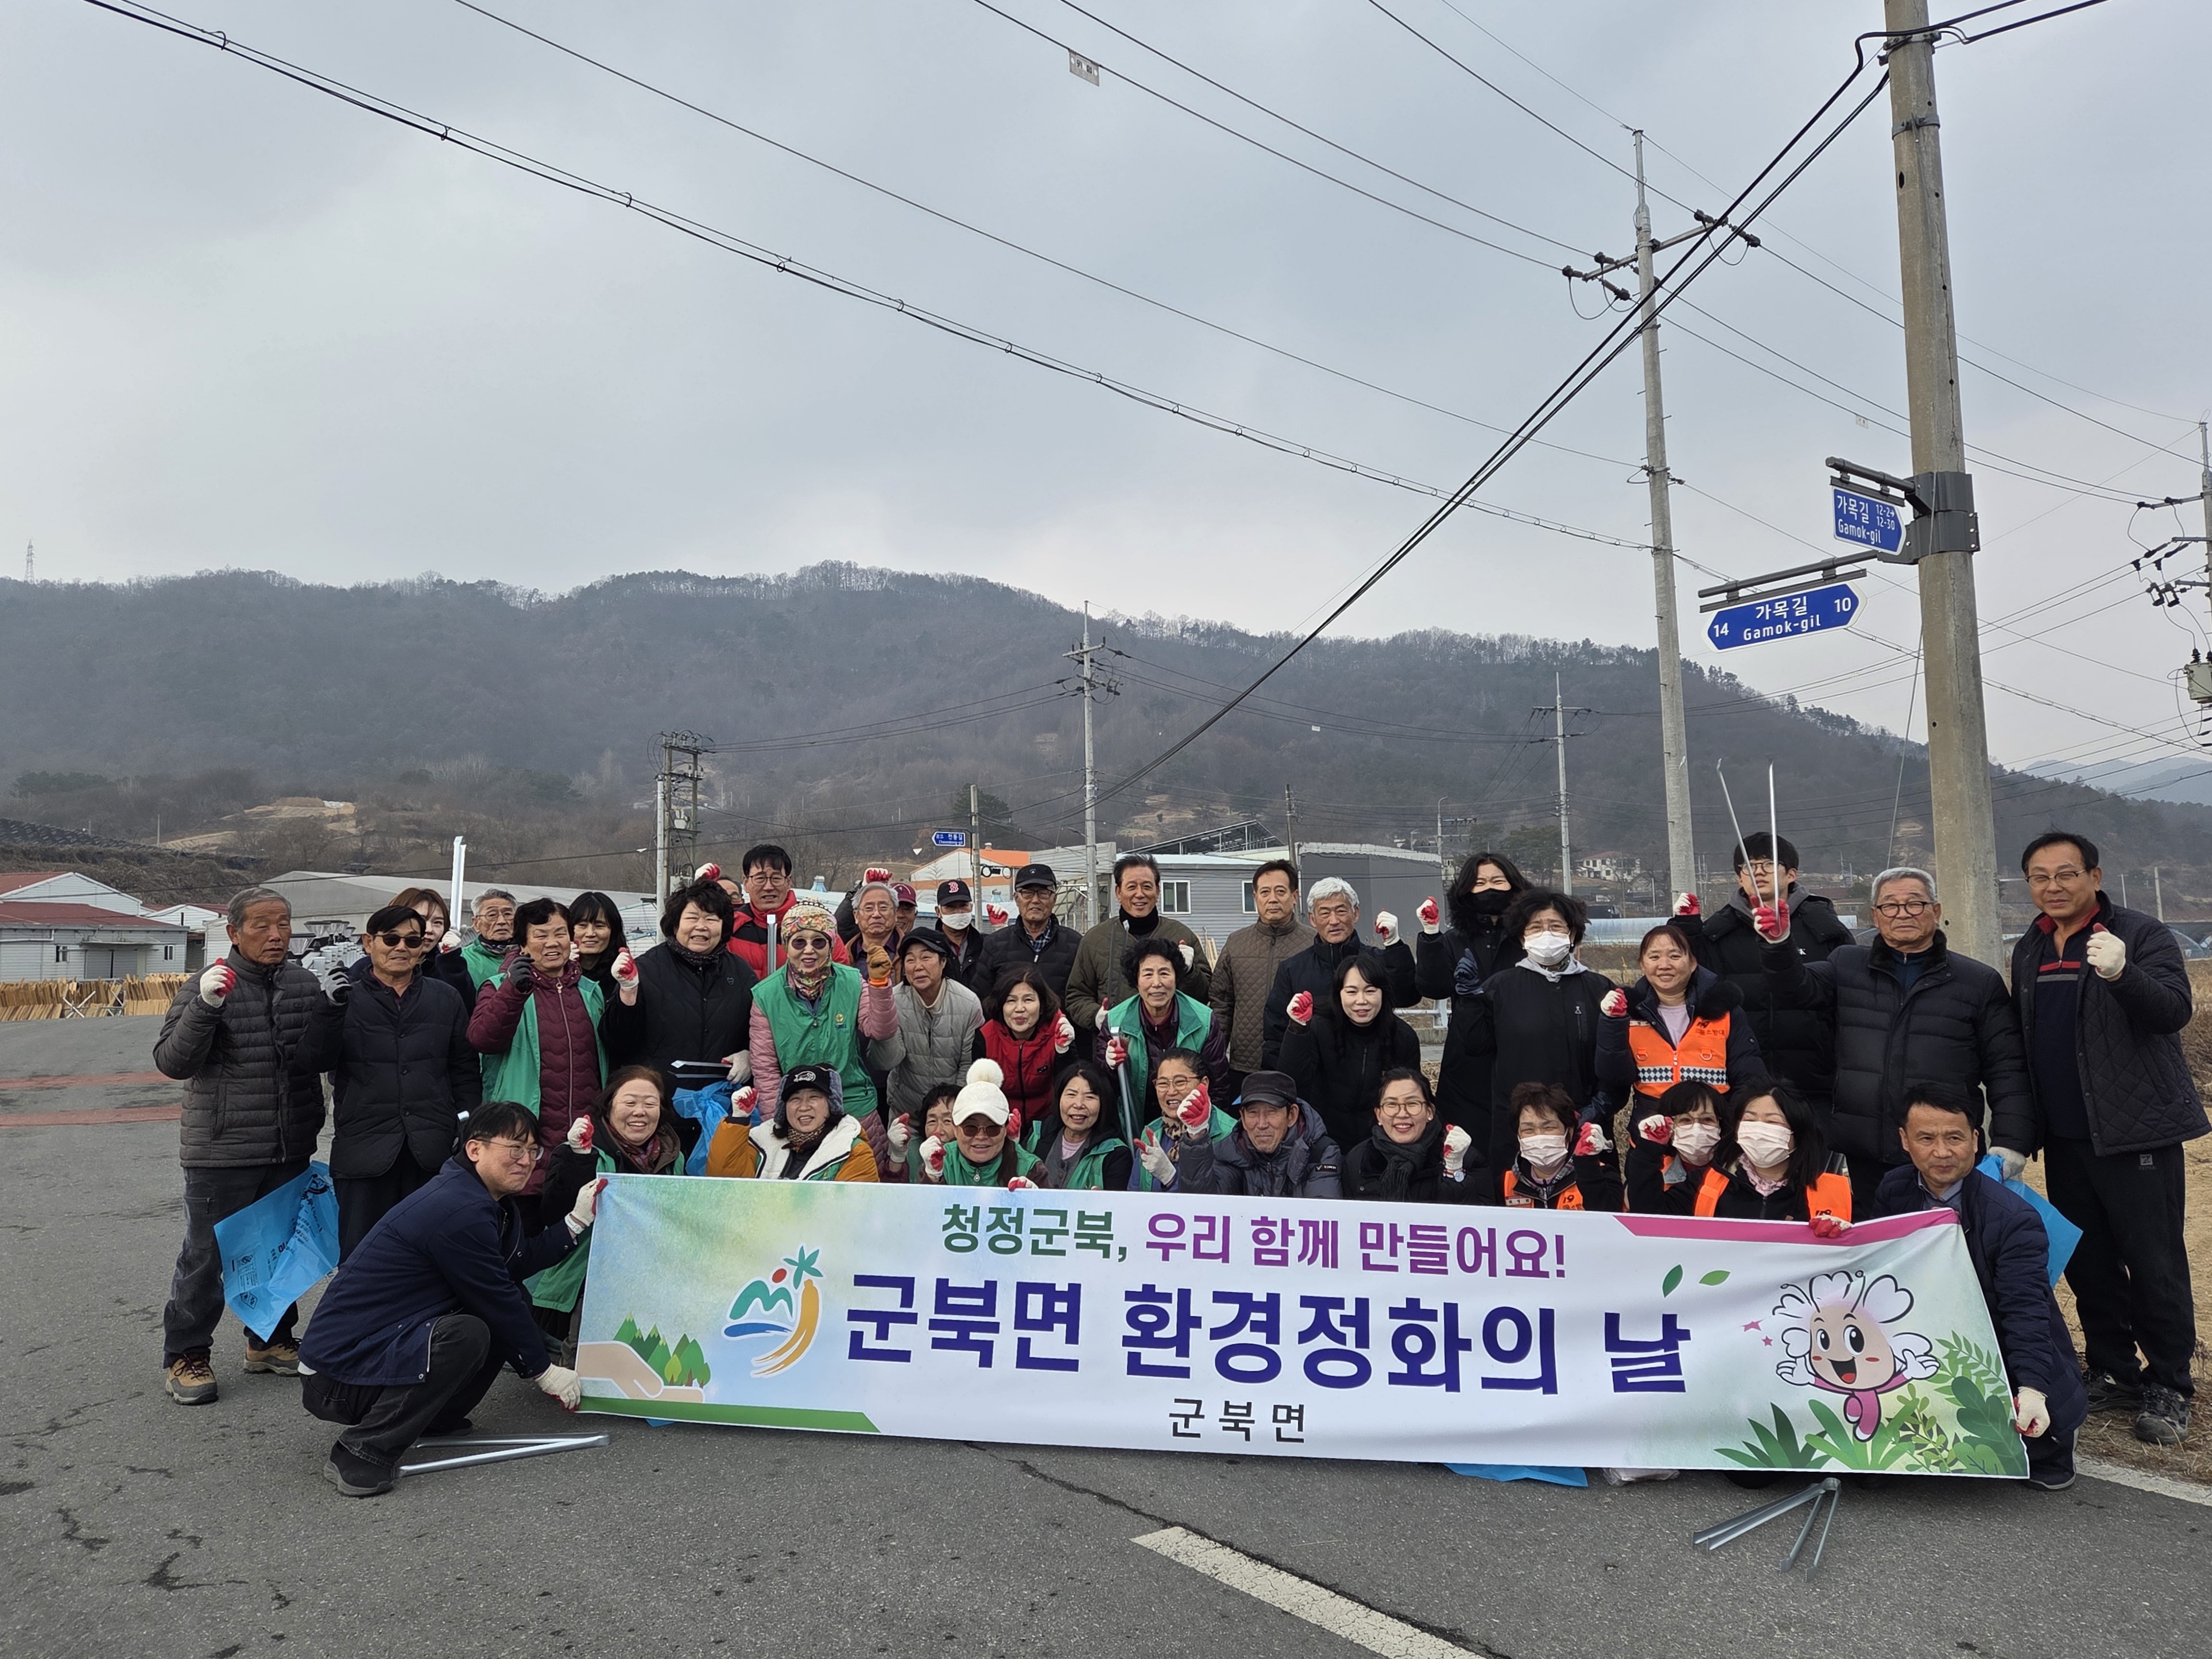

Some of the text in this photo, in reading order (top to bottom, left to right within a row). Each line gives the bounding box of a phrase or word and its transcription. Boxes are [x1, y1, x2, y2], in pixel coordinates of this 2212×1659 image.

[1837, 495, 1869, 524] 가목길
[1877, 516, 1895, 530] 12-30
[1838, 518, 1881, 545] Gamok-gil
[1713, 596, 1852, 638] 14 가목길 10
[1743, 614, 1821, 641] Gamok-gil
[948, 881, 959, 893] B
[942, 1204, 1566, 1279] 청정군북, 우리 함께 만들어요!
[846, 1274, 1692, 1395] 군북면 환경정화의 날
[1168, 1397, 1305, 1443] 군북면
